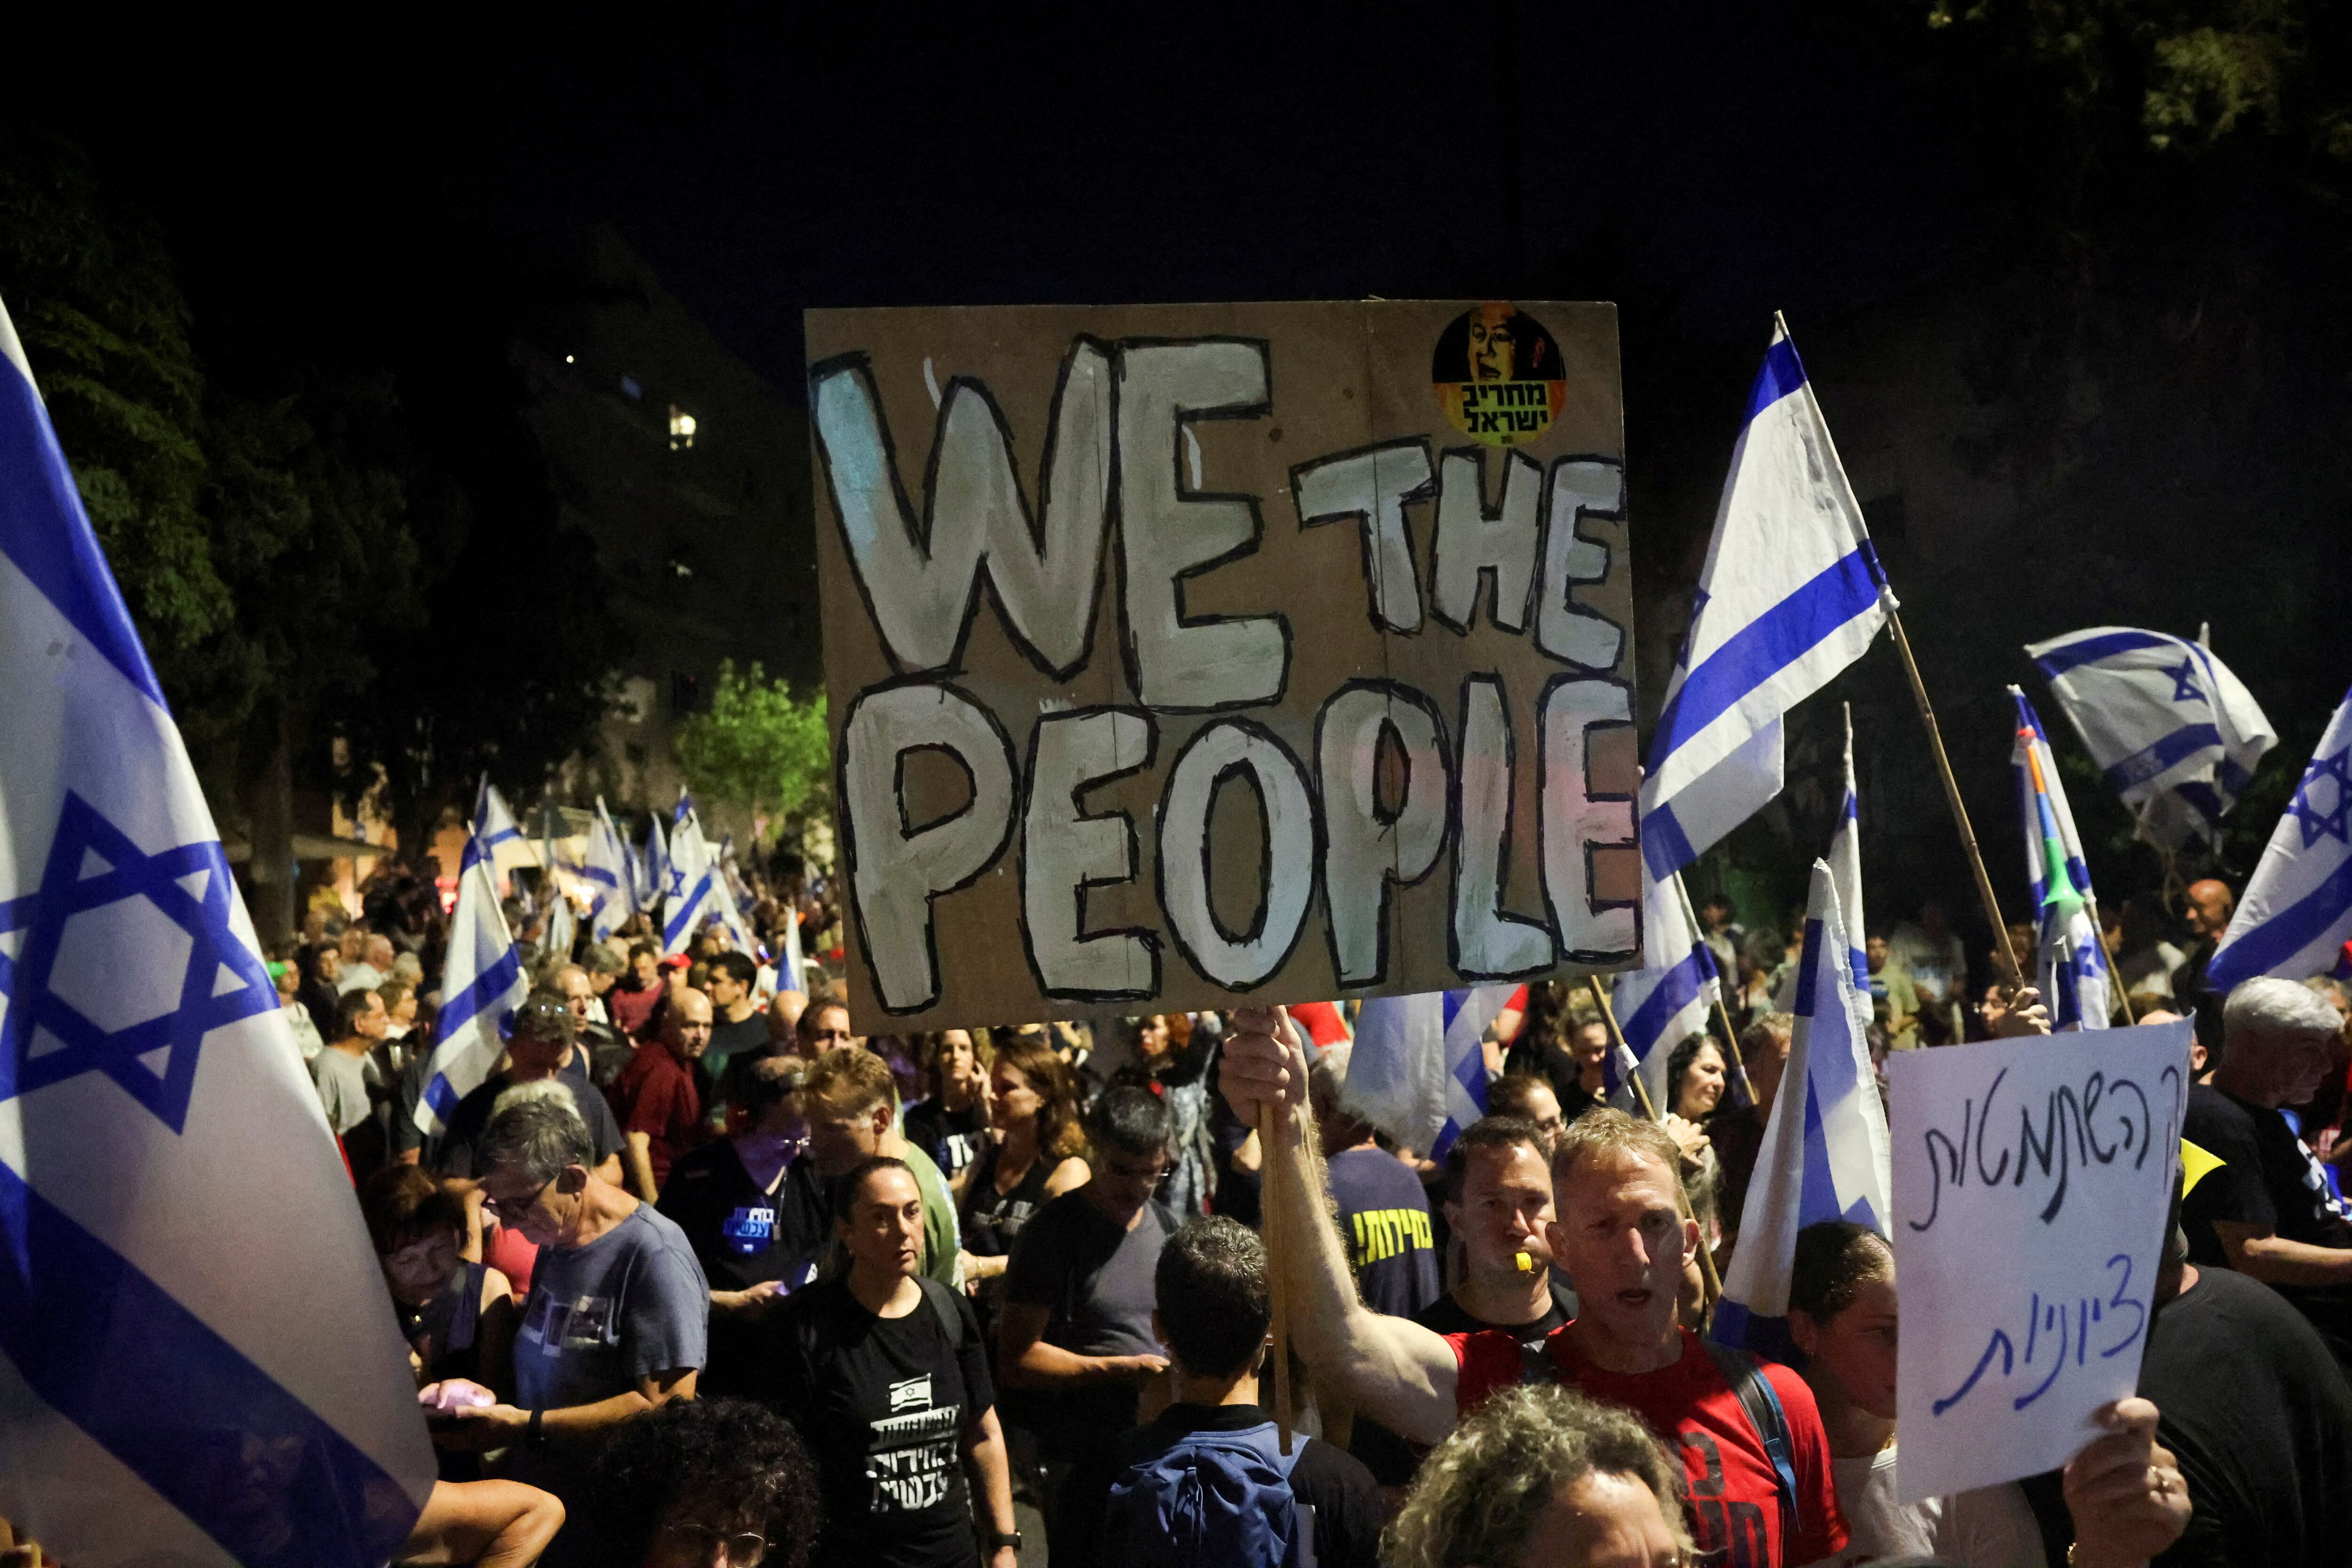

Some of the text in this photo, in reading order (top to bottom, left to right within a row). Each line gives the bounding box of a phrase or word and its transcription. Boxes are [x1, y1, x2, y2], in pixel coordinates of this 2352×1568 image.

[1462, 384, 1547, 407] מחריב
[1463, 409, 1548, 432] ישראל
[810, 333, 1626, 715] WE THE
[838, 672, 1642, 1014] PEOPLE
